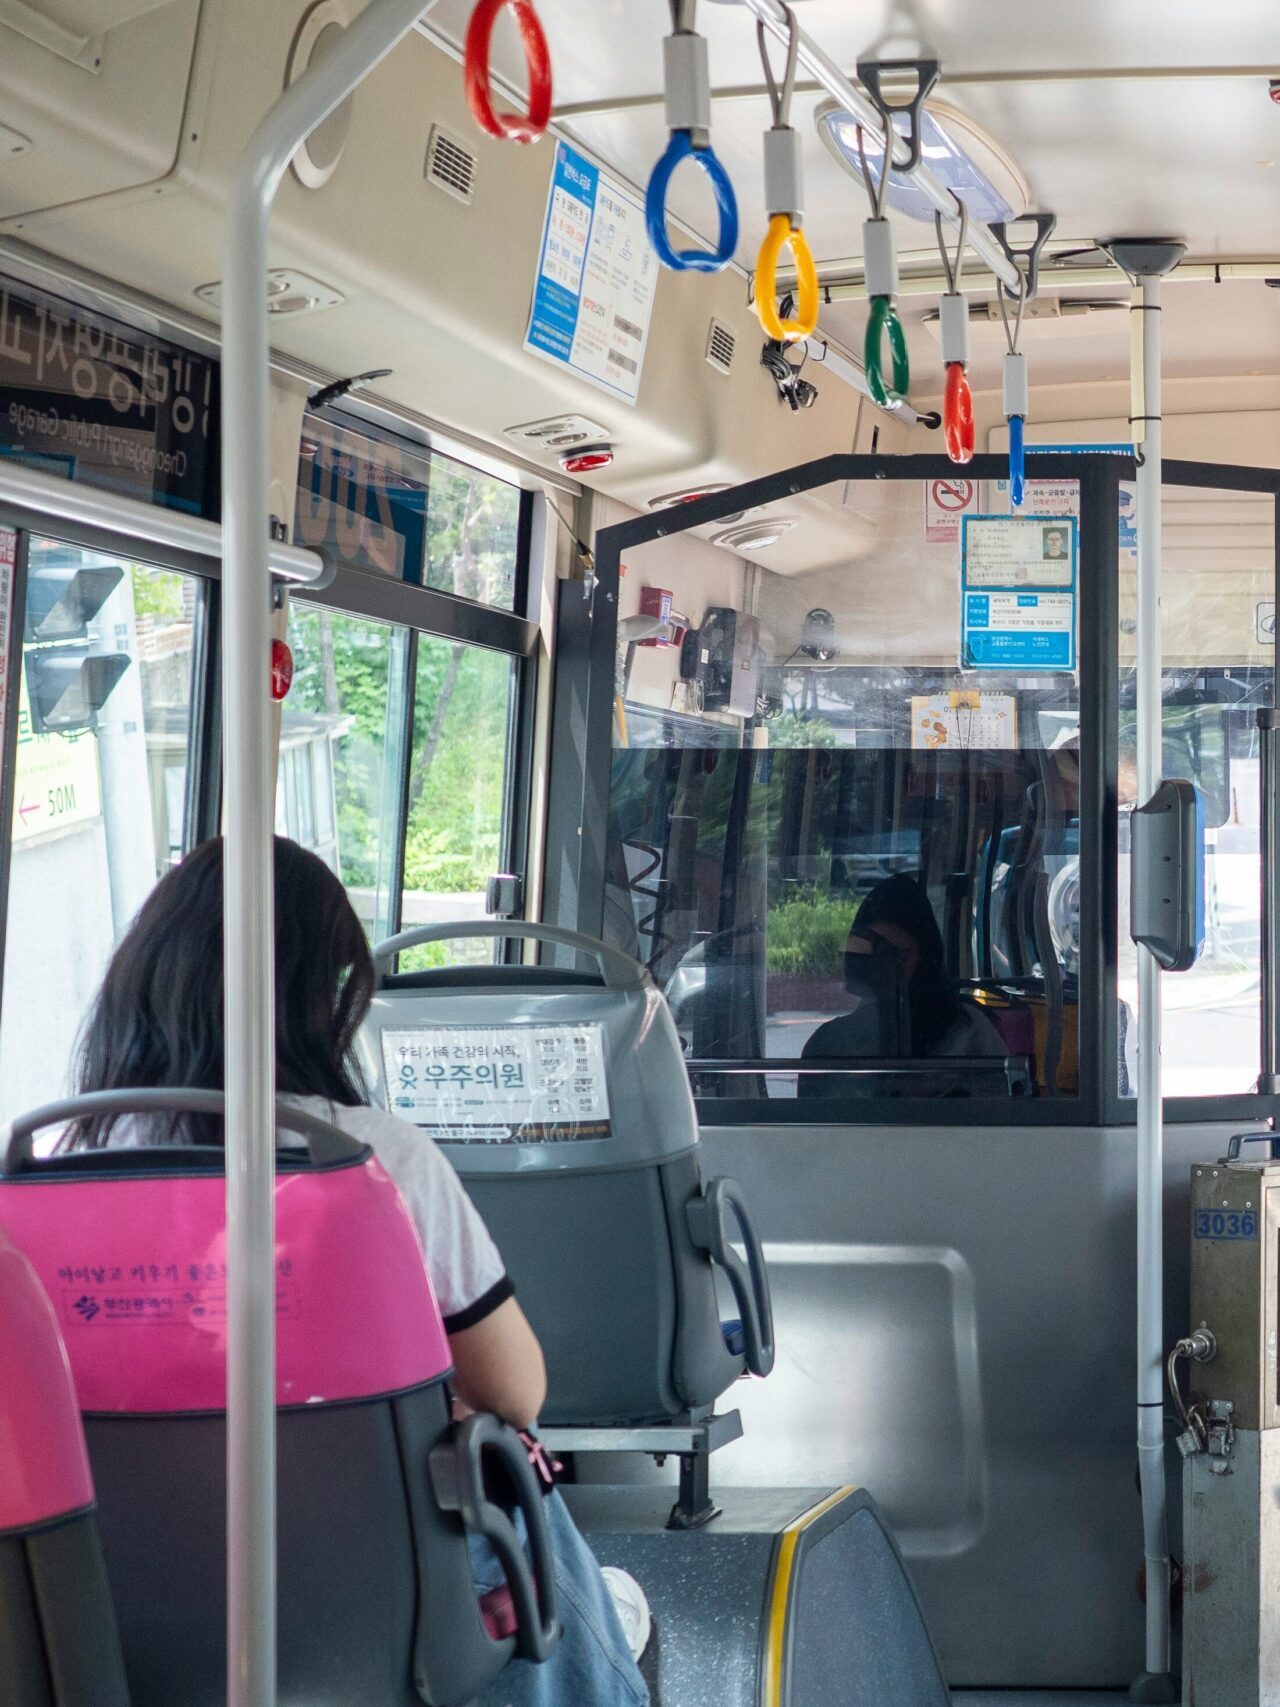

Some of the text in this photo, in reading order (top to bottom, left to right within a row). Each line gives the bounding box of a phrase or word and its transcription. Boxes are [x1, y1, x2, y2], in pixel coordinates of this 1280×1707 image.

[47, 783, 76, 817] 50M
[452, 1046, 489, 1059] 건강의
[424, 1062, 525, 1090] 우주의원
[1198, 1213, 1256, 1236] 3036
